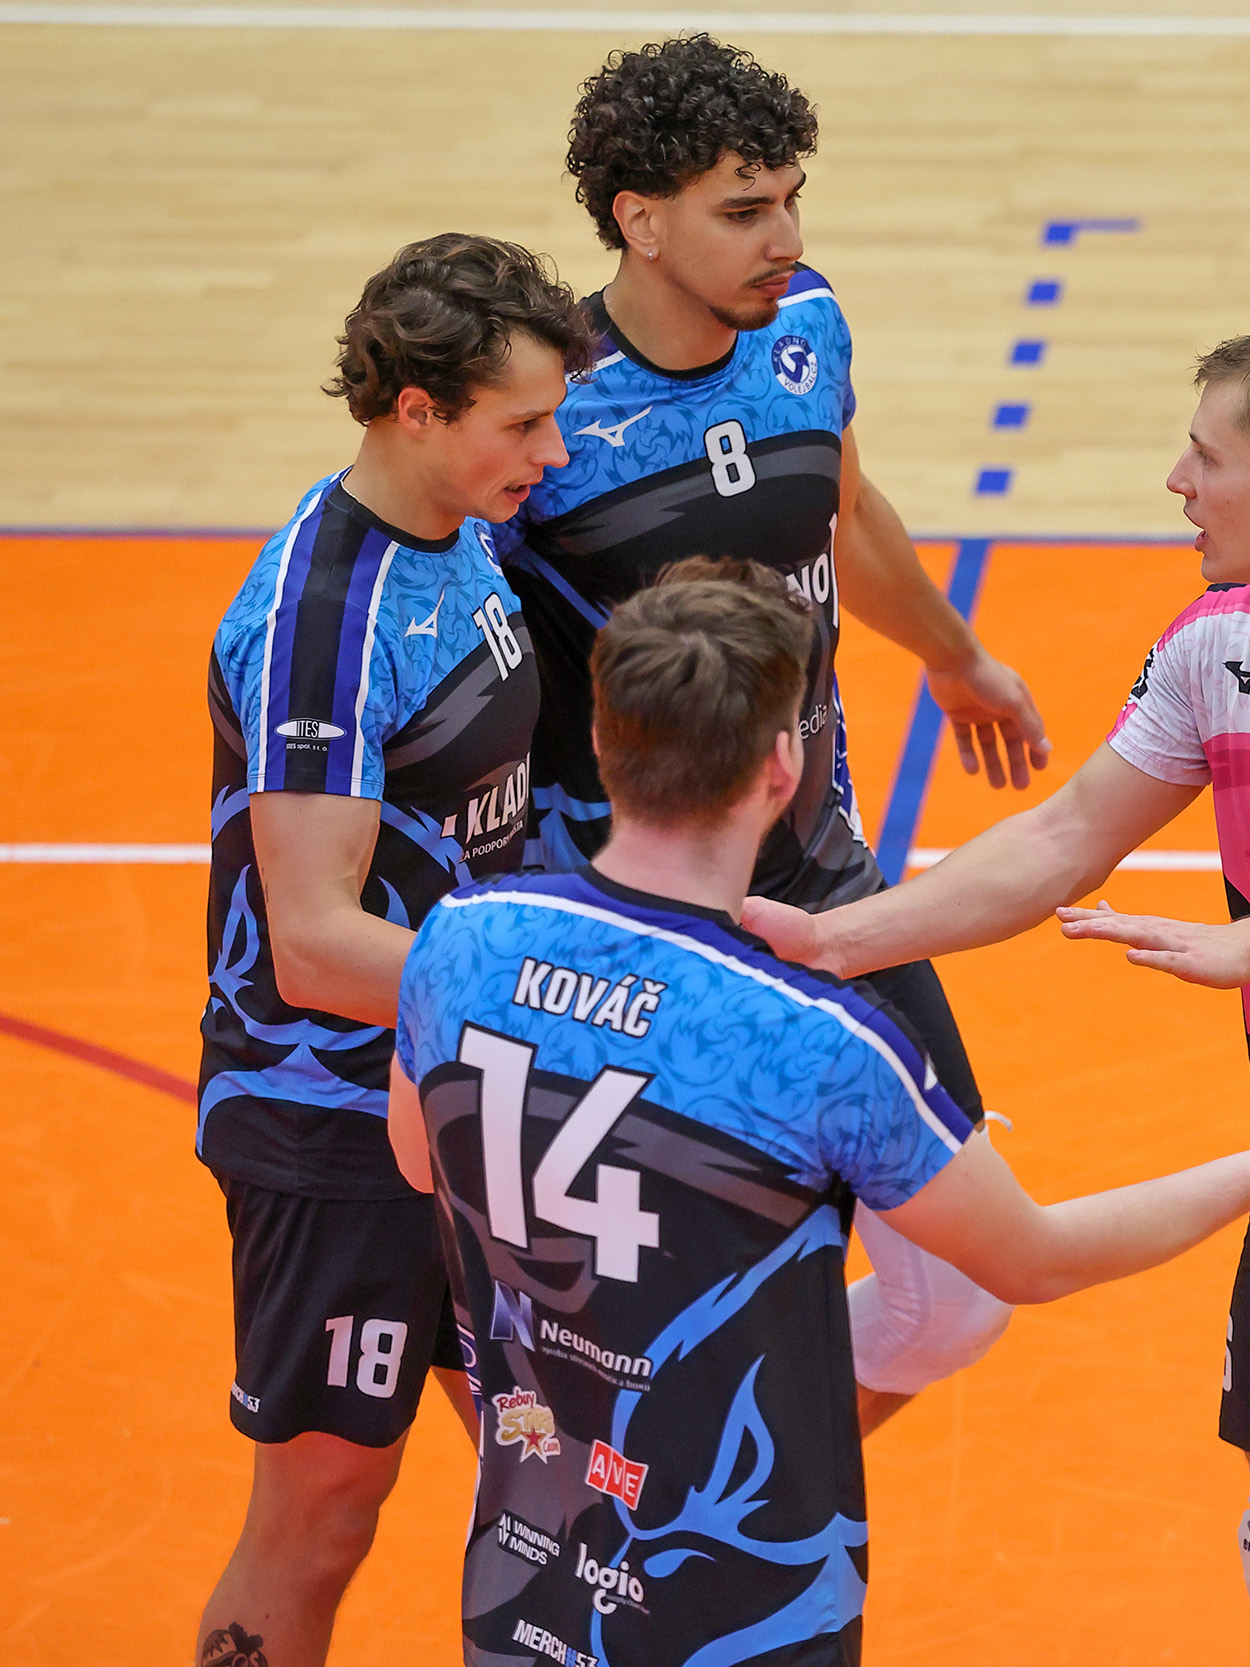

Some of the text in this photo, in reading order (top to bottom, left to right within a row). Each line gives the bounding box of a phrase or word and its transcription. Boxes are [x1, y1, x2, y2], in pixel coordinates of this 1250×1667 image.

[704, 420, 756, 497] 8
[472, 592, 524, 682] 18
[297, 720, 319, 738] ITES
[799, 704, 828, 740] edia
[512, 957, 668, 1038] KOVÁČ
[458, 1021, 661, 1284] 14
[325, 1315, 408, 1399] 18
[540, 1319, 652, 1377] Neumann
[497, 1389, 535, 1412] Rebuy
[592, 1454, 640, 1497] AVE
[509, 1536, 548, 1565] MINDS
[513, 1520, 561, 1557] WINNING
[575, 1542, 645, 1614] logio
